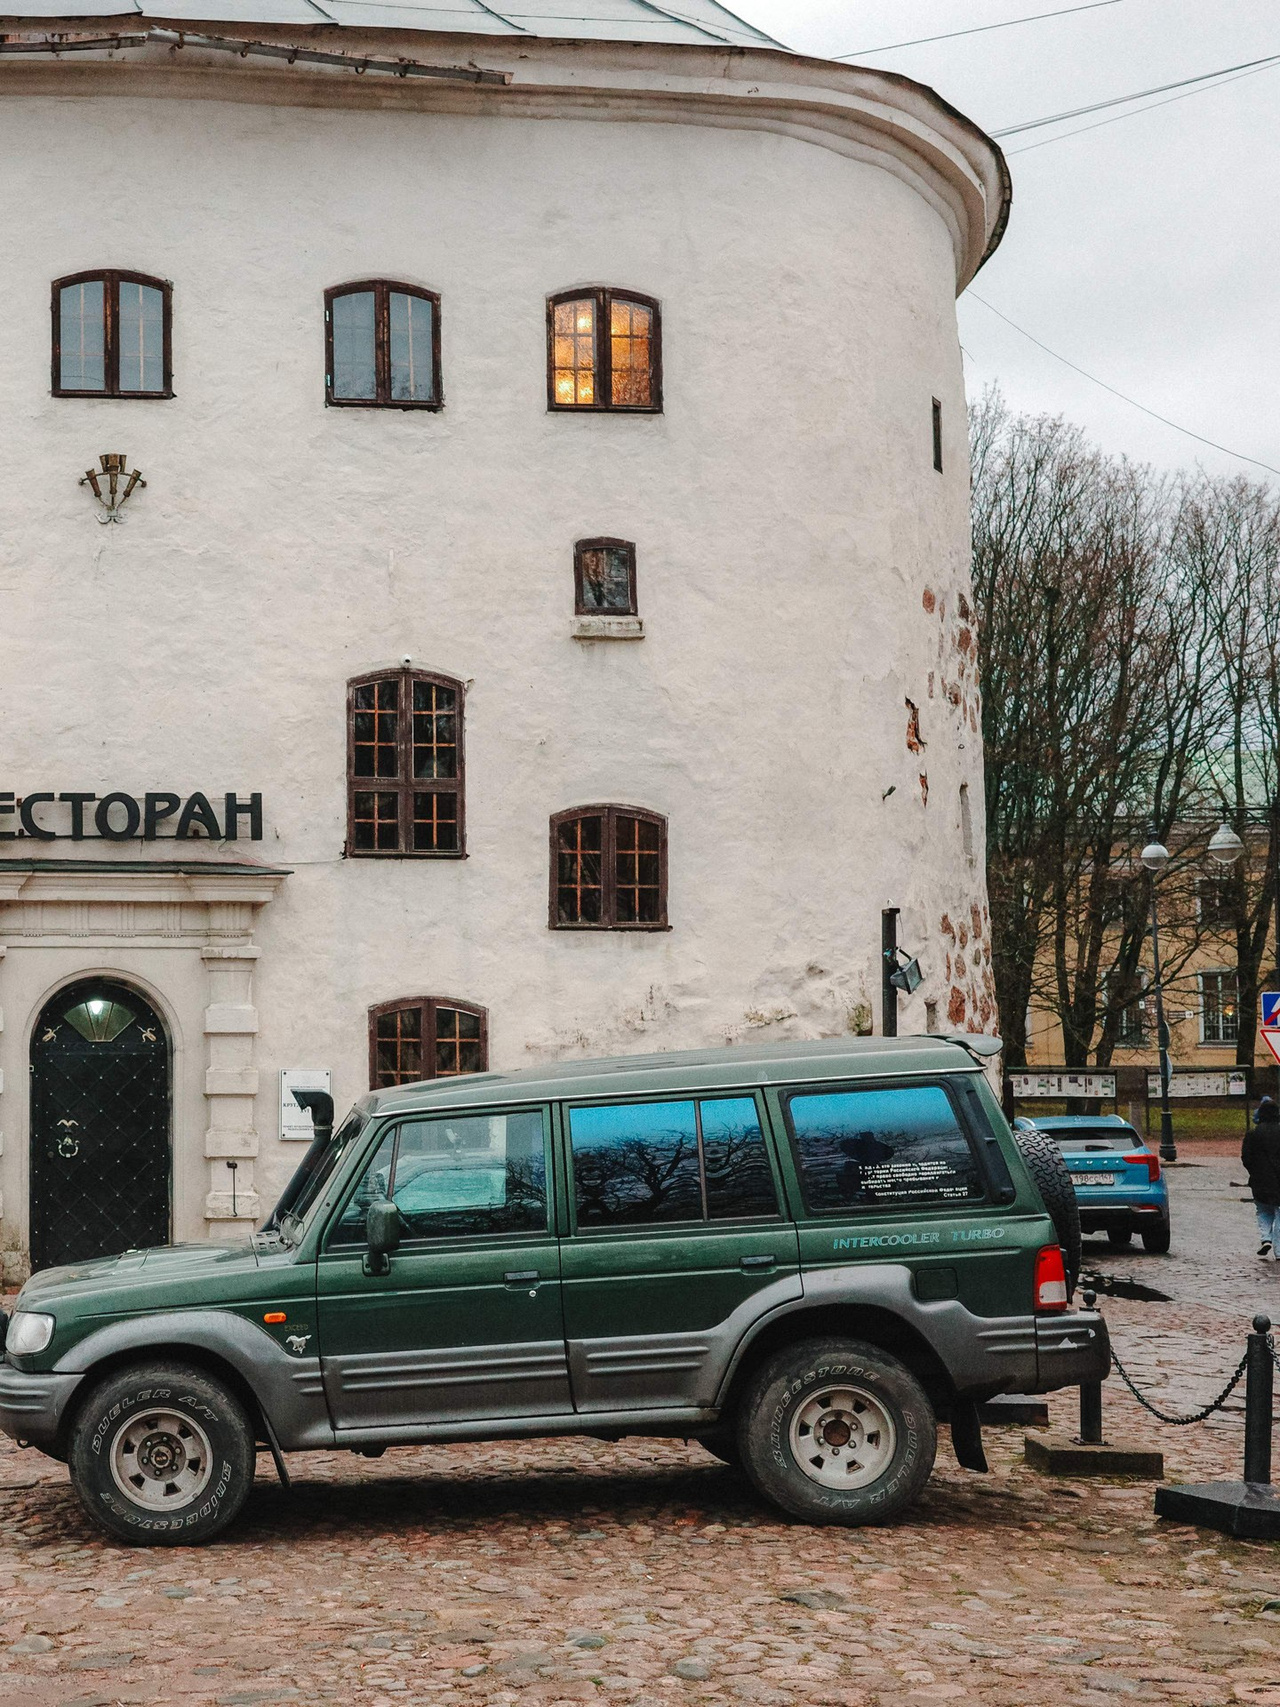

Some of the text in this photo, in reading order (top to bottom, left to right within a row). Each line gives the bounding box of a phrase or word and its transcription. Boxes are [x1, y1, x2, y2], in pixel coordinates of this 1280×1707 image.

[833, 1227, 1005, 1250] INTERCOOLER TURBO
[91, 1388, 219, 1455] DUELER A/T
[770, 1365, 881, 1469] BRIDGESTONE
[870, 1410, 918, 1505] DUELER
